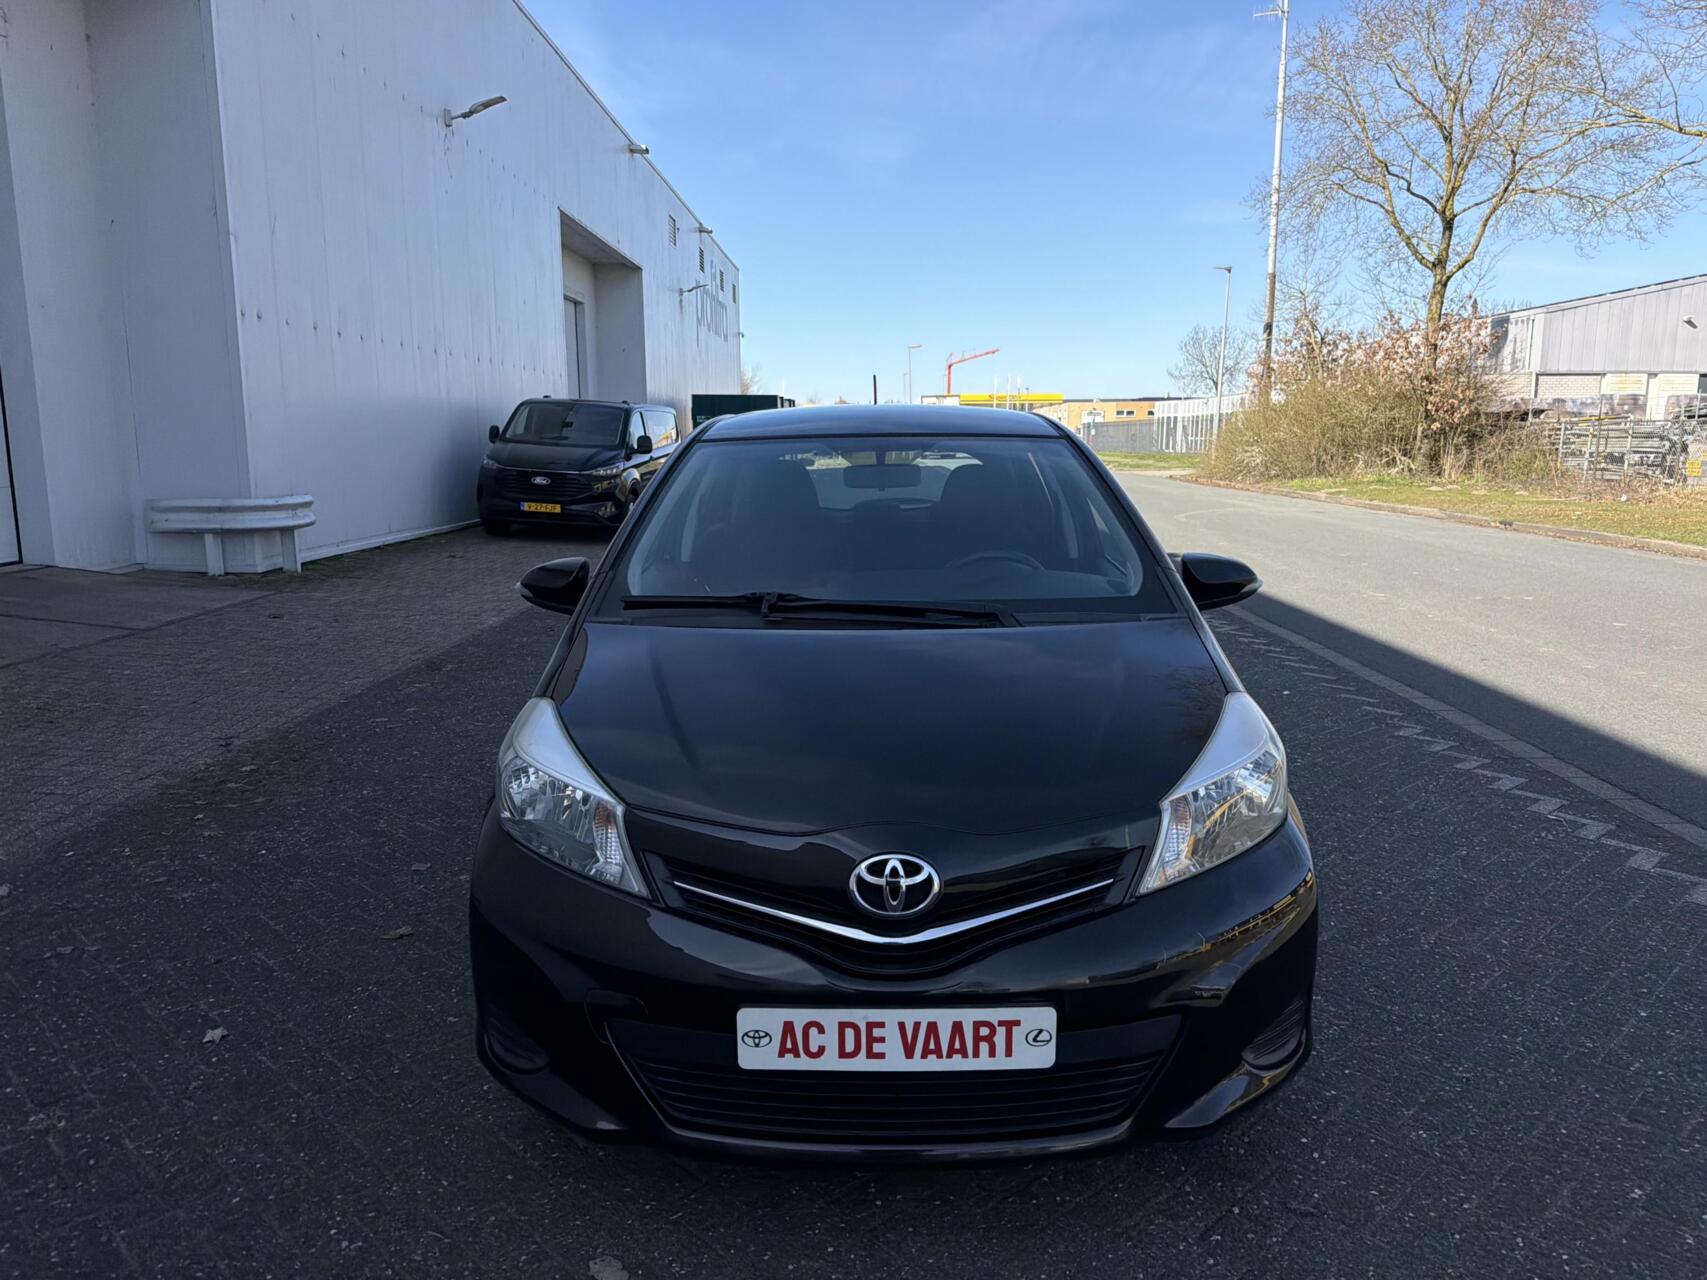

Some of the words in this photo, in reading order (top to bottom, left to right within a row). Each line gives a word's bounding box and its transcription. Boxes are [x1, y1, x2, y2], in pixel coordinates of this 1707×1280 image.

[777, 1020, 826, 1059] AC
[837, 1020, 886, 1060] DE
[897, 1019, 1021, 1060] VAART
